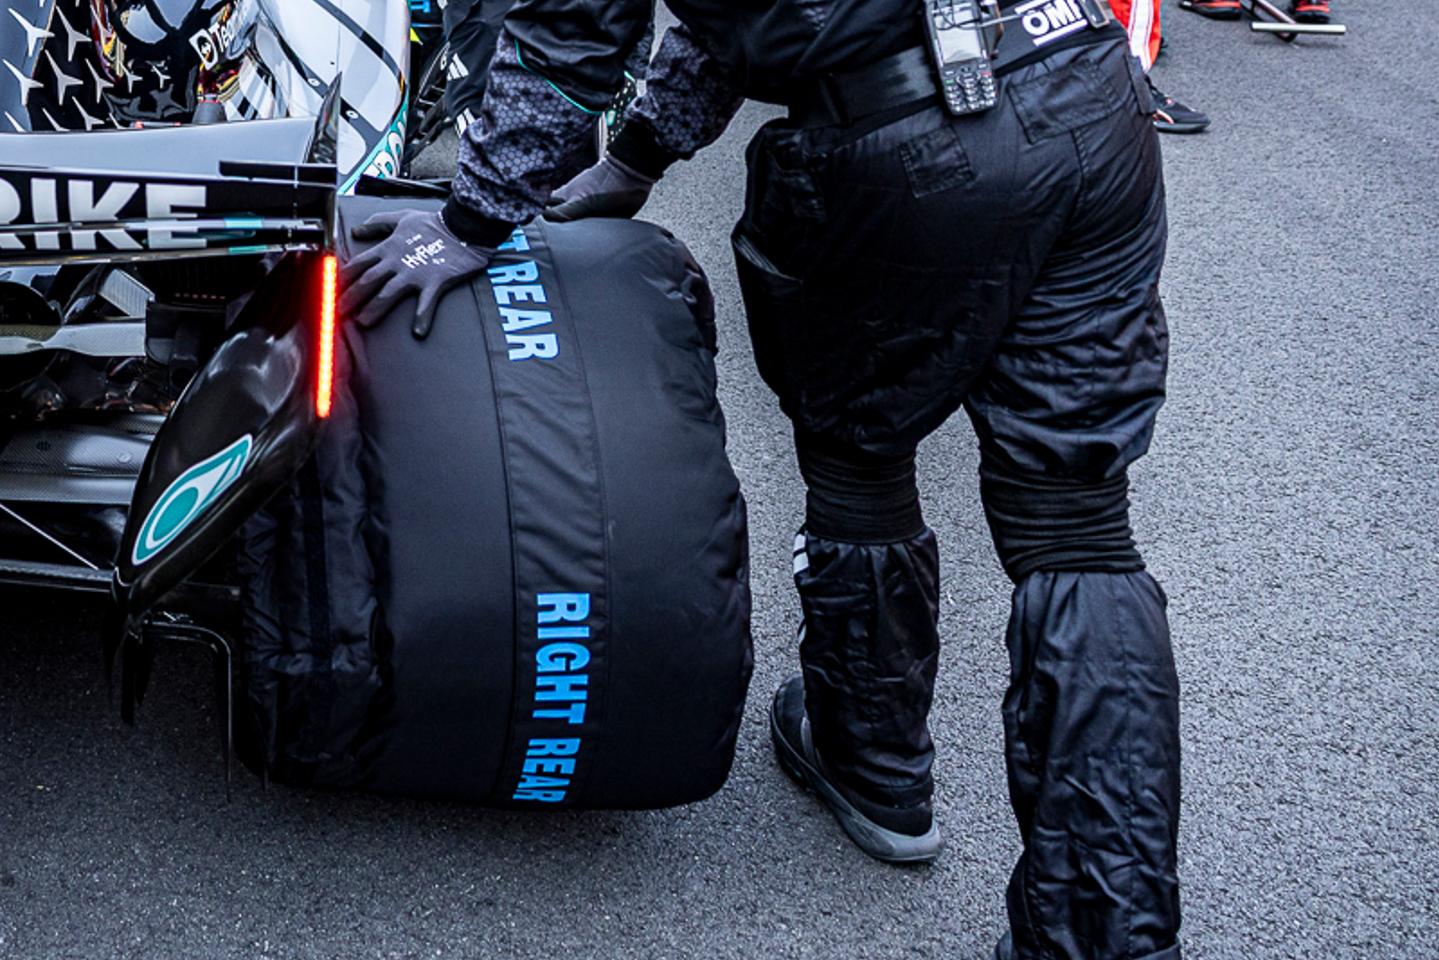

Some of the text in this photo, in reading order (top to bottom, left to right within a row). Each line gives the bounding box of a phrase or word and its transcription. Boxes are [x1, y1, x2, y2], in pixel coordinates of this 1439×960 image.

[401, 238, 447, 269] HyFlex
[487, 260, 561, 362] REAR
[511, 591, 591, 804] RIGHT REAR
